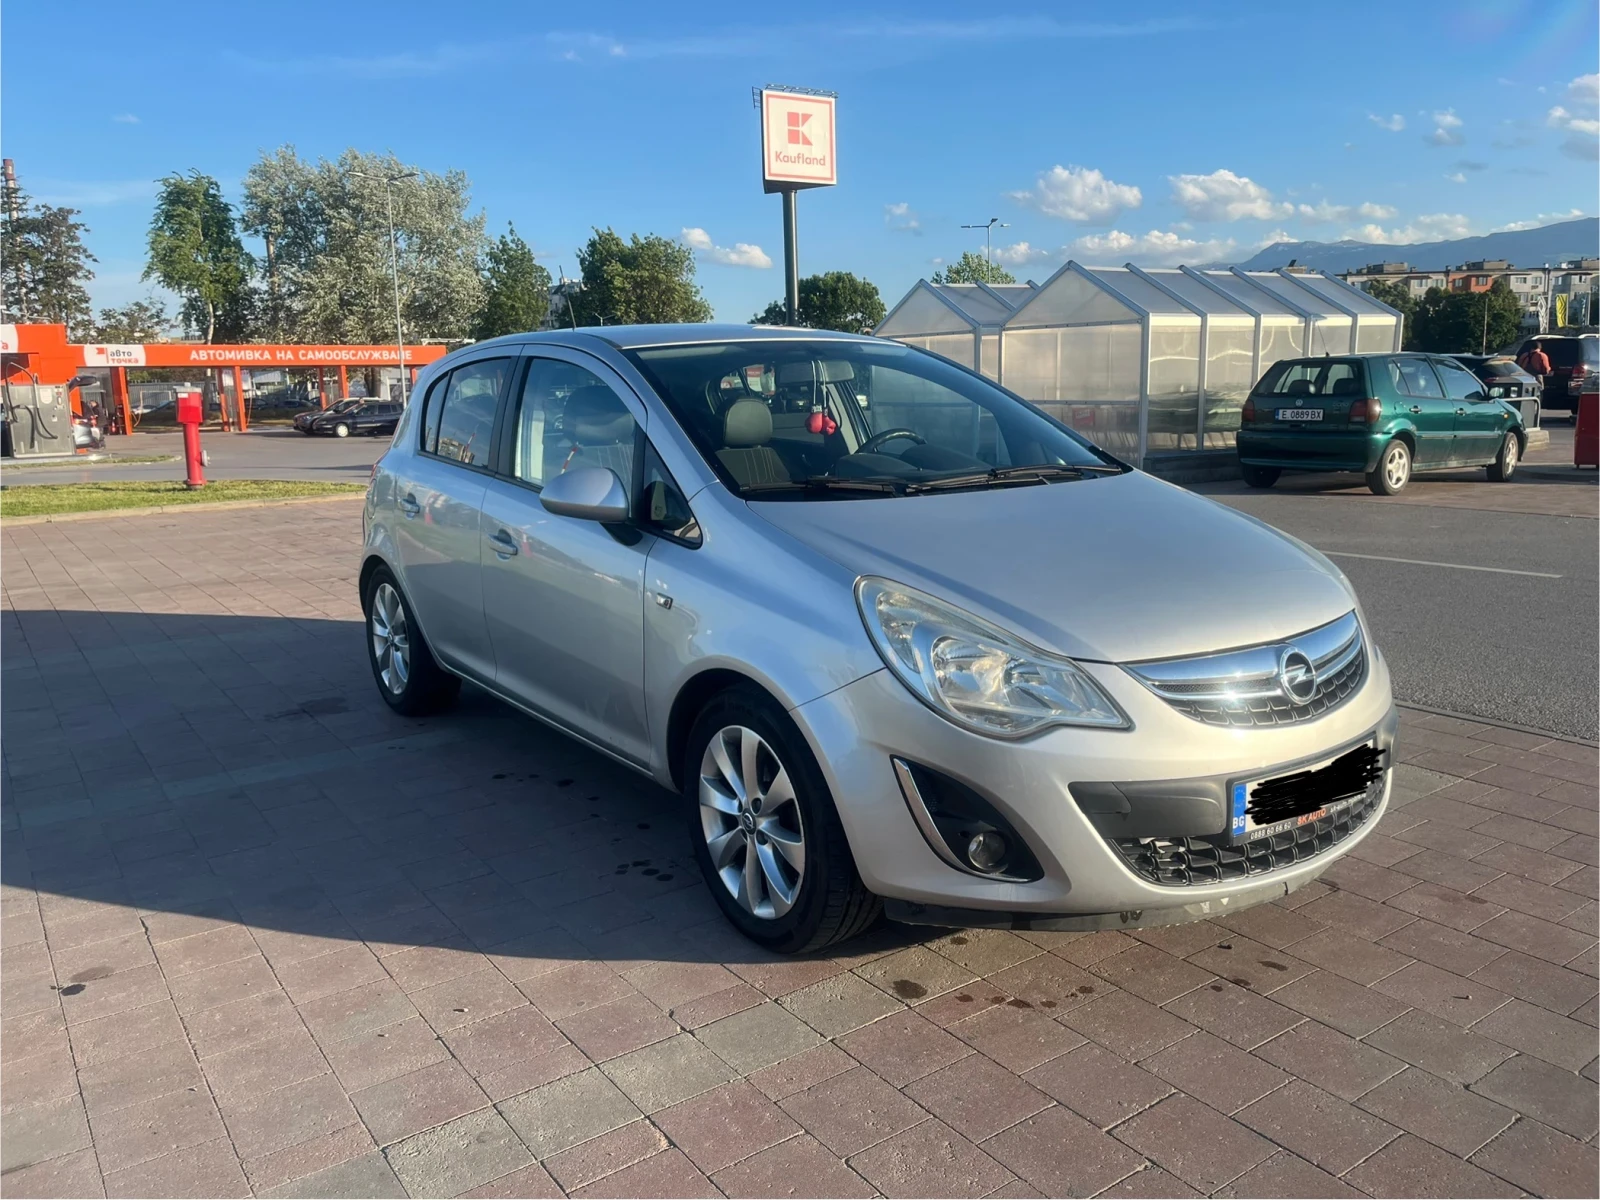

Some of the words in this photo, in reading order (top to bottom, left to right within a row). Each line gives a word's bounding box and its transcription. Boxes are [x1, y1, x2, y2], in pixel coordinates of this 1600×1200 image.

[775, 151, 826, 166] Kaufland
[190, 350, 271, 360] АВТОМИВКА
[276, 350, 294, 360] НА
[1232, 816, 1245, 829] BG
[1297, 815, 1309, 825] SK
[1308, 808, 1327, 821] AUTO
